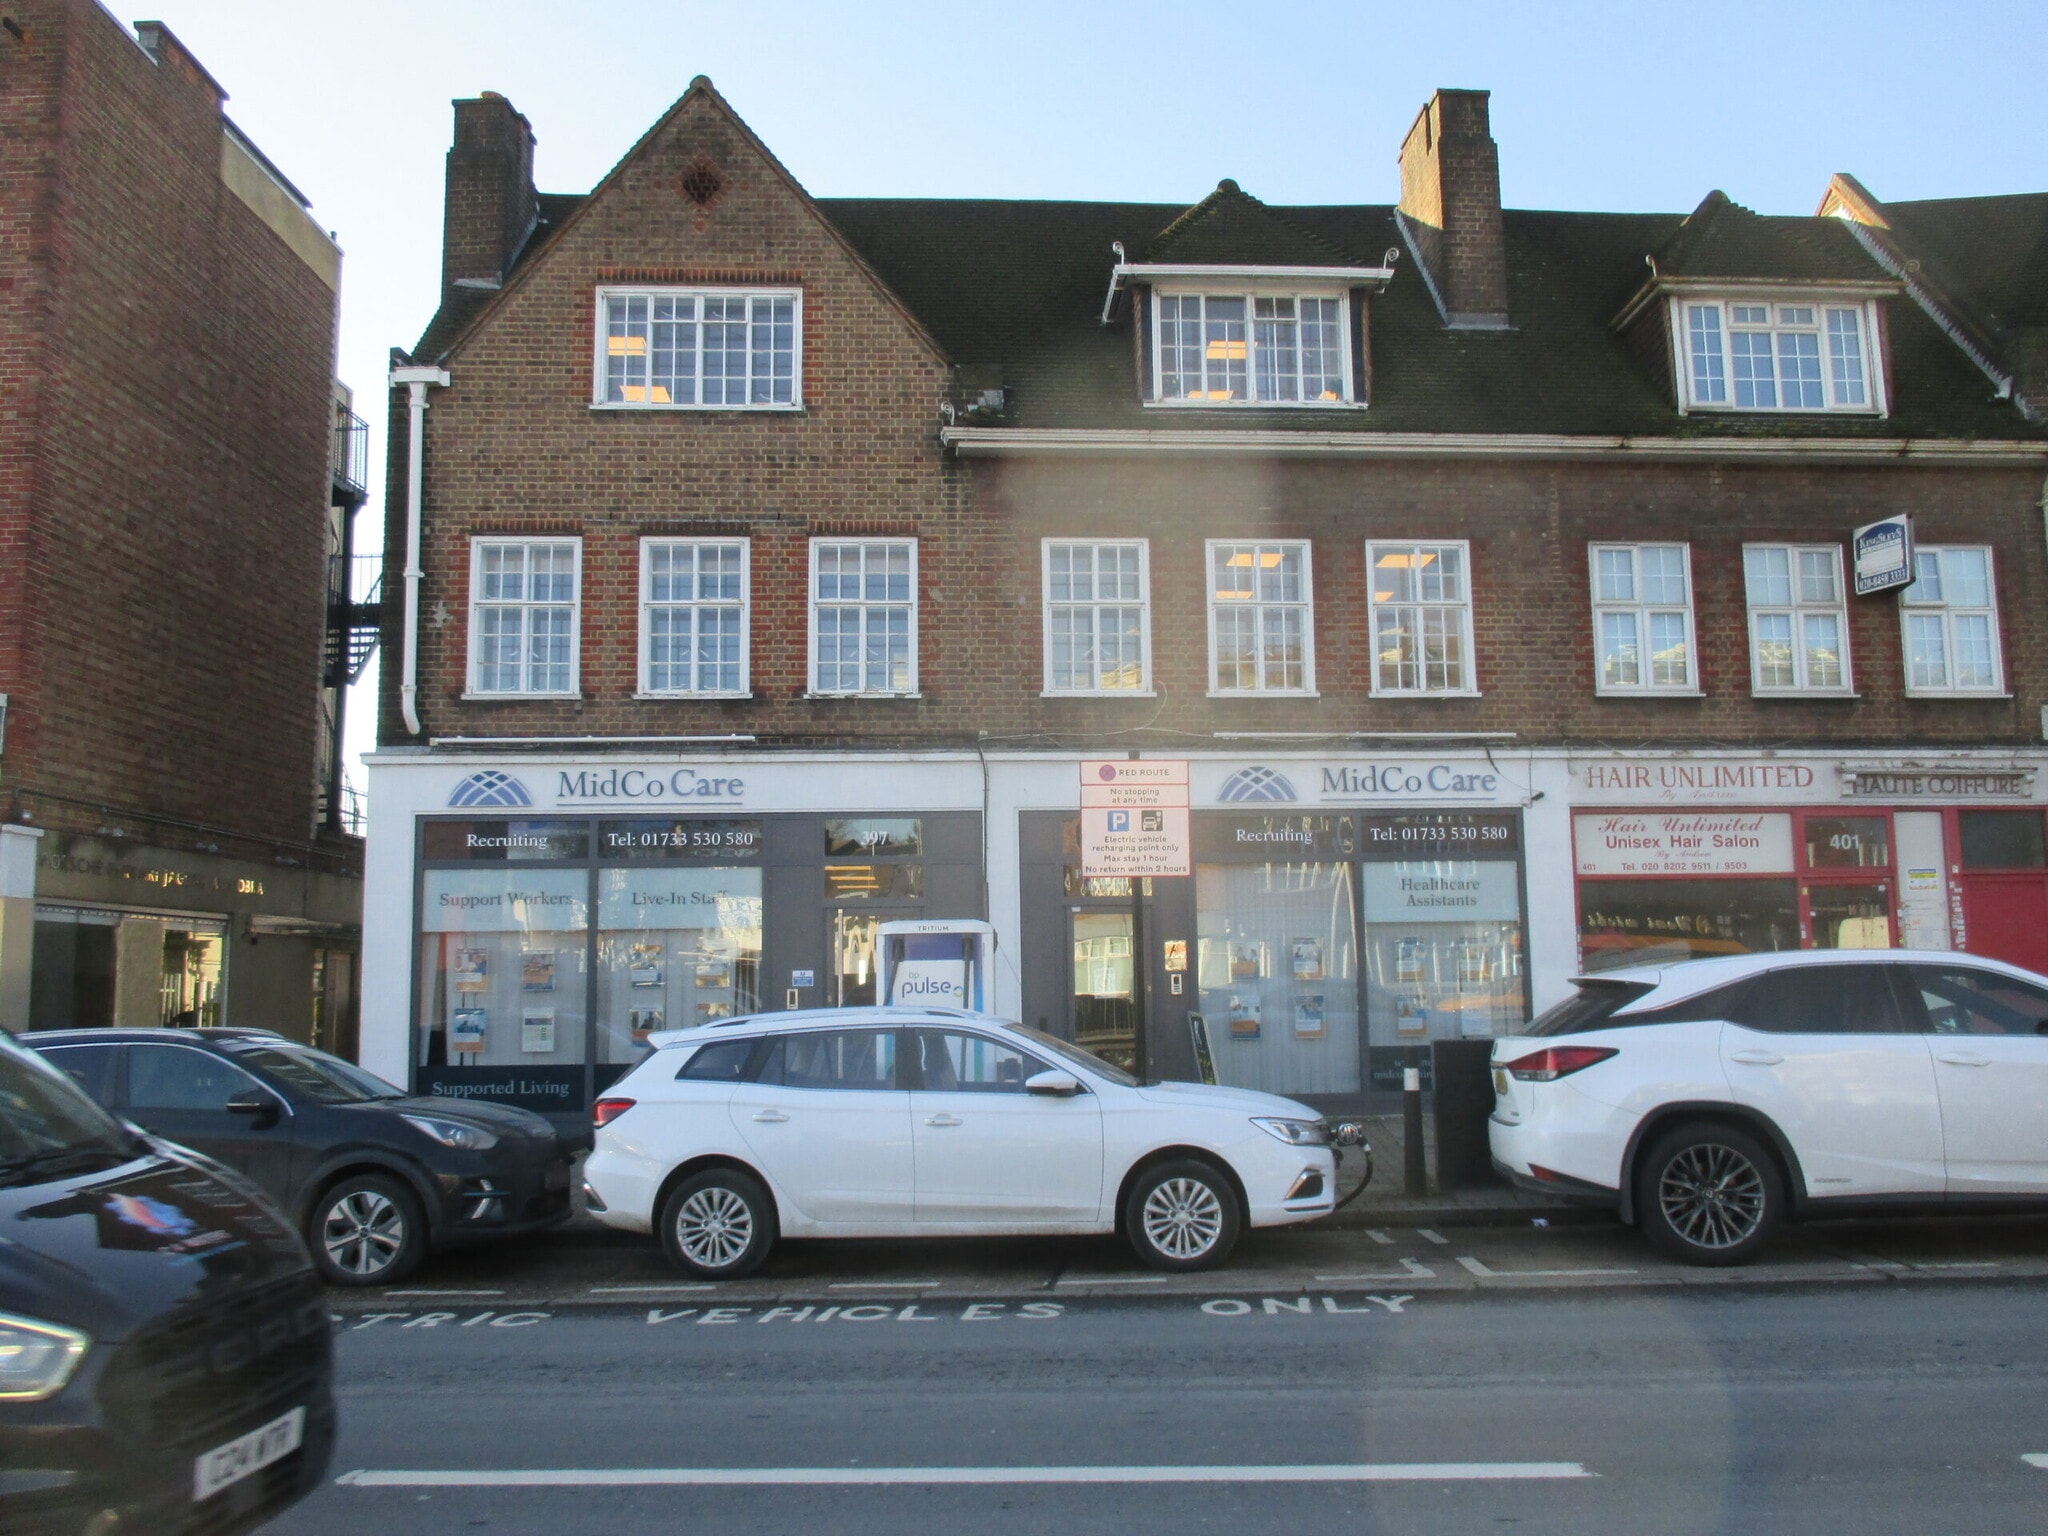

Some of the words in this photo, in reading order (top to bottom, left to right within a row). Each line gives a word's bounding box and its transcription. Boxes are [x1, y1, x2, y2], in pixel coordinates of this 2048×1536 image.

[557, 769, 664, 798] MidCo
[671, 769, 745, 797] Care
[1321, 766, 1421, 793] MidCo
[1427, 765, 1497, 792] Care
[1587, 766, 1651, 788] HAIR
[1660, 765, 1815, 788] UNLIMITED
[1852, 775, 1924, 795] HAUTE
[1927, 774, 2021, 794] COIFFURE
[1124, 788, 1160, 796] stopping
[1112, 812, 1127, 830] P
[1598, 816, 1648, 832] Hair
[1660, 815, 1764, 832] Unlimited
[466, 833, 549, 850] Recruiting
[608, 833, 636, 847] Tel:
[641, 832, 688, 847] 01733
[693, 832, 721, 846] 530
[725, 832, 753, 846] 580
[860, 831, 889, 847] 397
[1235, 828, 1313, 844] Recruiting
[1370, 828, 1397, 842] Tel:
[1402, 827, 1446, 841] 01733
[1451, 827, 1477, 841] 530
[1481, 826, 1508, 840] 580
[1605, 835, 1661, 849] Unisex
[1670, 834, 1703, 848] Hair
[1712, 833, 1760, 848] Salon
[1829, 833, 1860, 850] 401
[1092, 845, 1136, 853] recharging
[1162, 844, 1179, 852] only
[1123, 855, 1140, 863] stay
[1641, 863, 1659, 871] 020
[1664, 862, 1687, 871] 8202
[1691, 862, 1711, 870] 9511
[1724, 861, 1747, 870] 9503
[1128, 865, 1153, 873] within
[1400, 878, 1481, 892] Healthcare
[439, 892, 503, 909] Support
[507, 891, 574, 907] Workers
[632, 891, 686, 905] Live-In
[1405, 894, 1478, 907] Assistants
[902, 976, 952, 999] pulse
[431, 1079, 515, 1099] Supported
[519, 1079, 570, 1098] Living
[645, 1302, 1067, 1326] VEHICLES
[1200, 1294, 1416, 1316] ONLY
